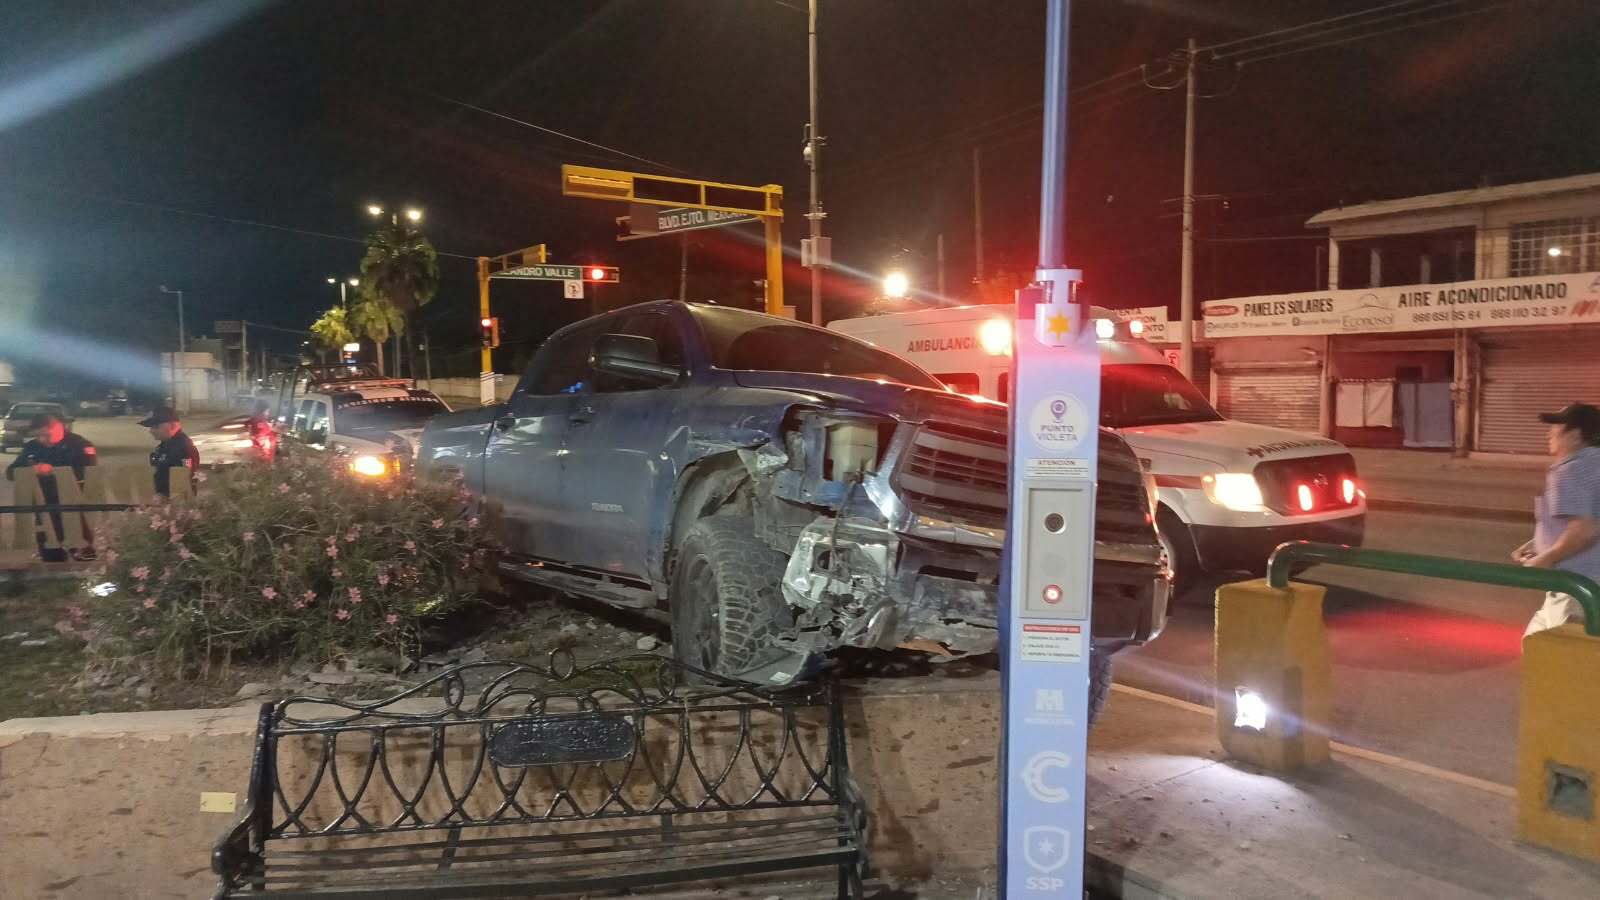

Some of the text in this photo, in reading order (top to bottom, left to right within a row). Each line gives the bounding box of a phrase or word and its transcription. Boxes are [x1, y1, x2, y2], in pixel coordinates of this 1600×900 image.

[544, 267, 575, 277] VALLE
[1398, 282, 1567, 308] AIRE ACONDICIONADO
[1244, 301, 1286, 317] PANELES
[1288, 298, 1334, 314] SOLARES
[907, 337, 979, 353] AMBULANCI
[1040, 424, 1074, 433] PUNTO
[1036, 433, 1078, 441] VIOLETA
[1025, 877, 1065, 891] SSP
